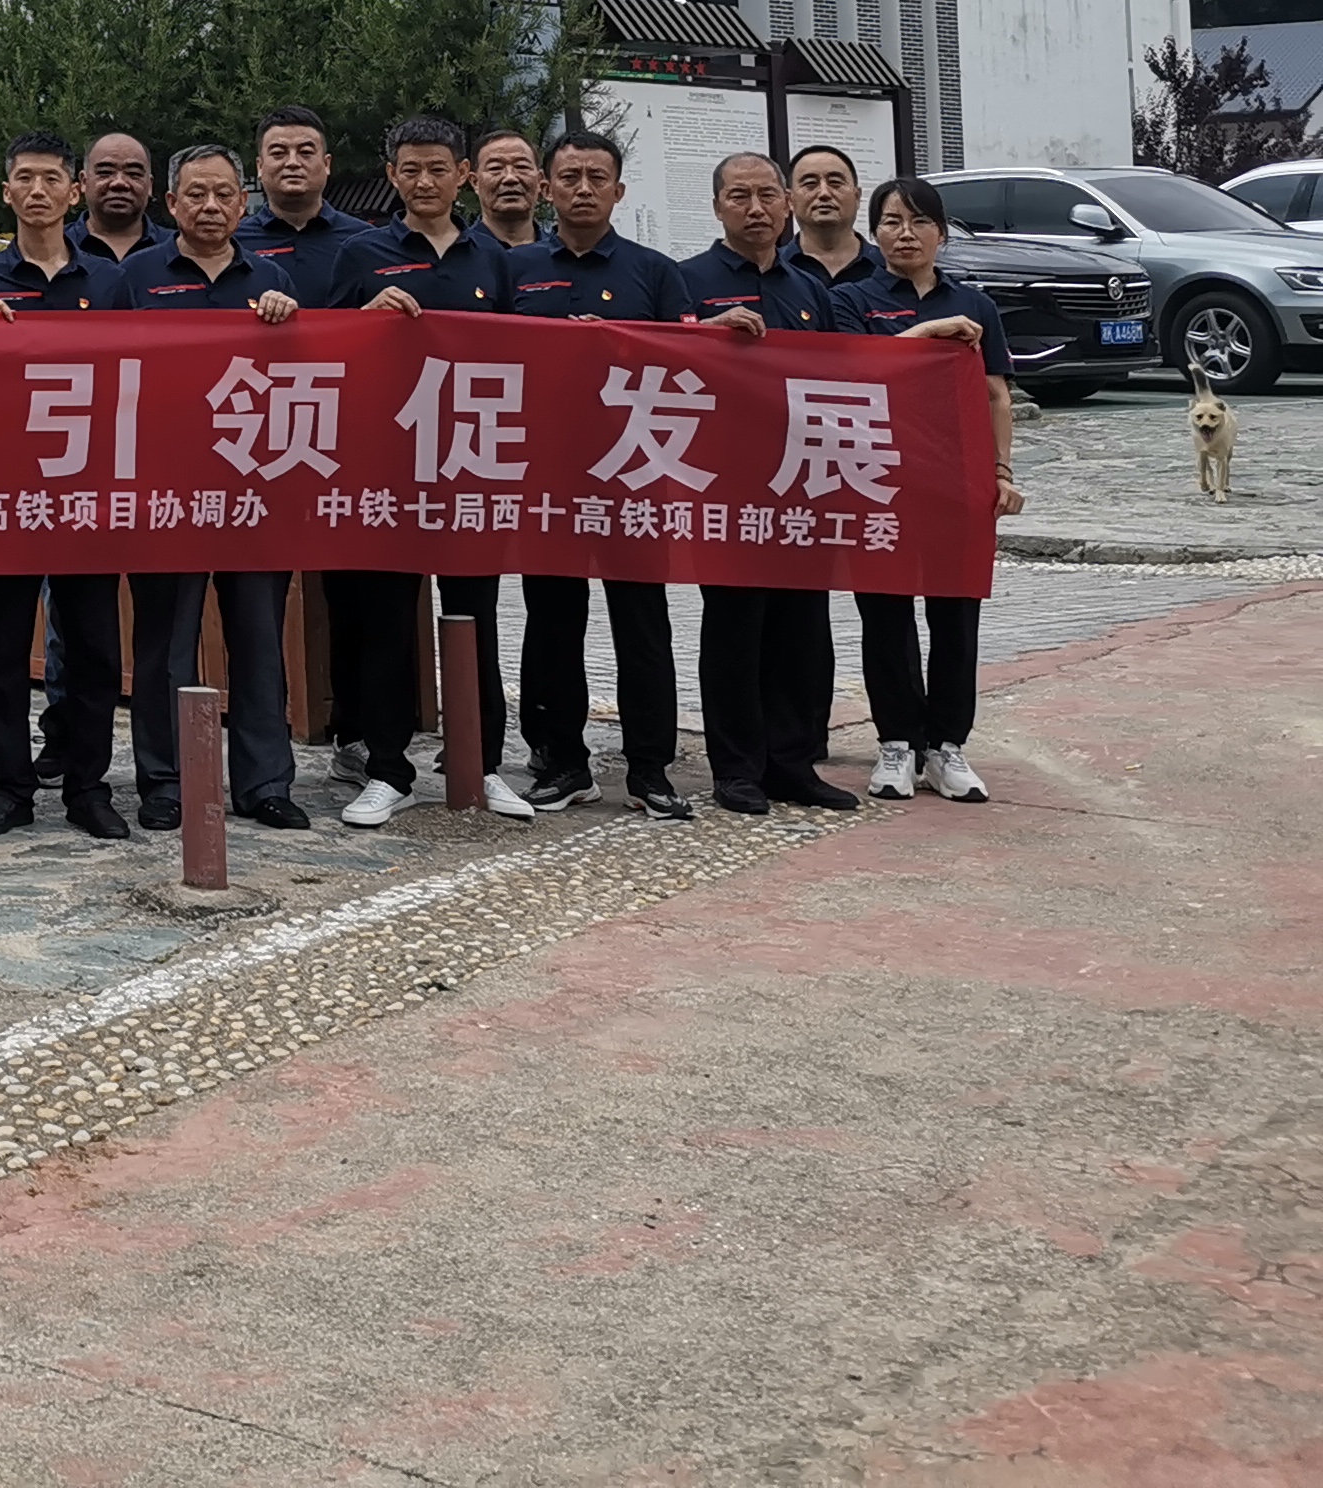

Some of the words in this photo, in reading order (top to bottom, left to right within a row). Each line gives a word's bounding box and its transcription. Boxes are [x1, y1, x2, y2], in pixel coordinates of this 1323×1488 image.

[315, 487, 901, 553] 中铁七局西十高铁项目部党工委
